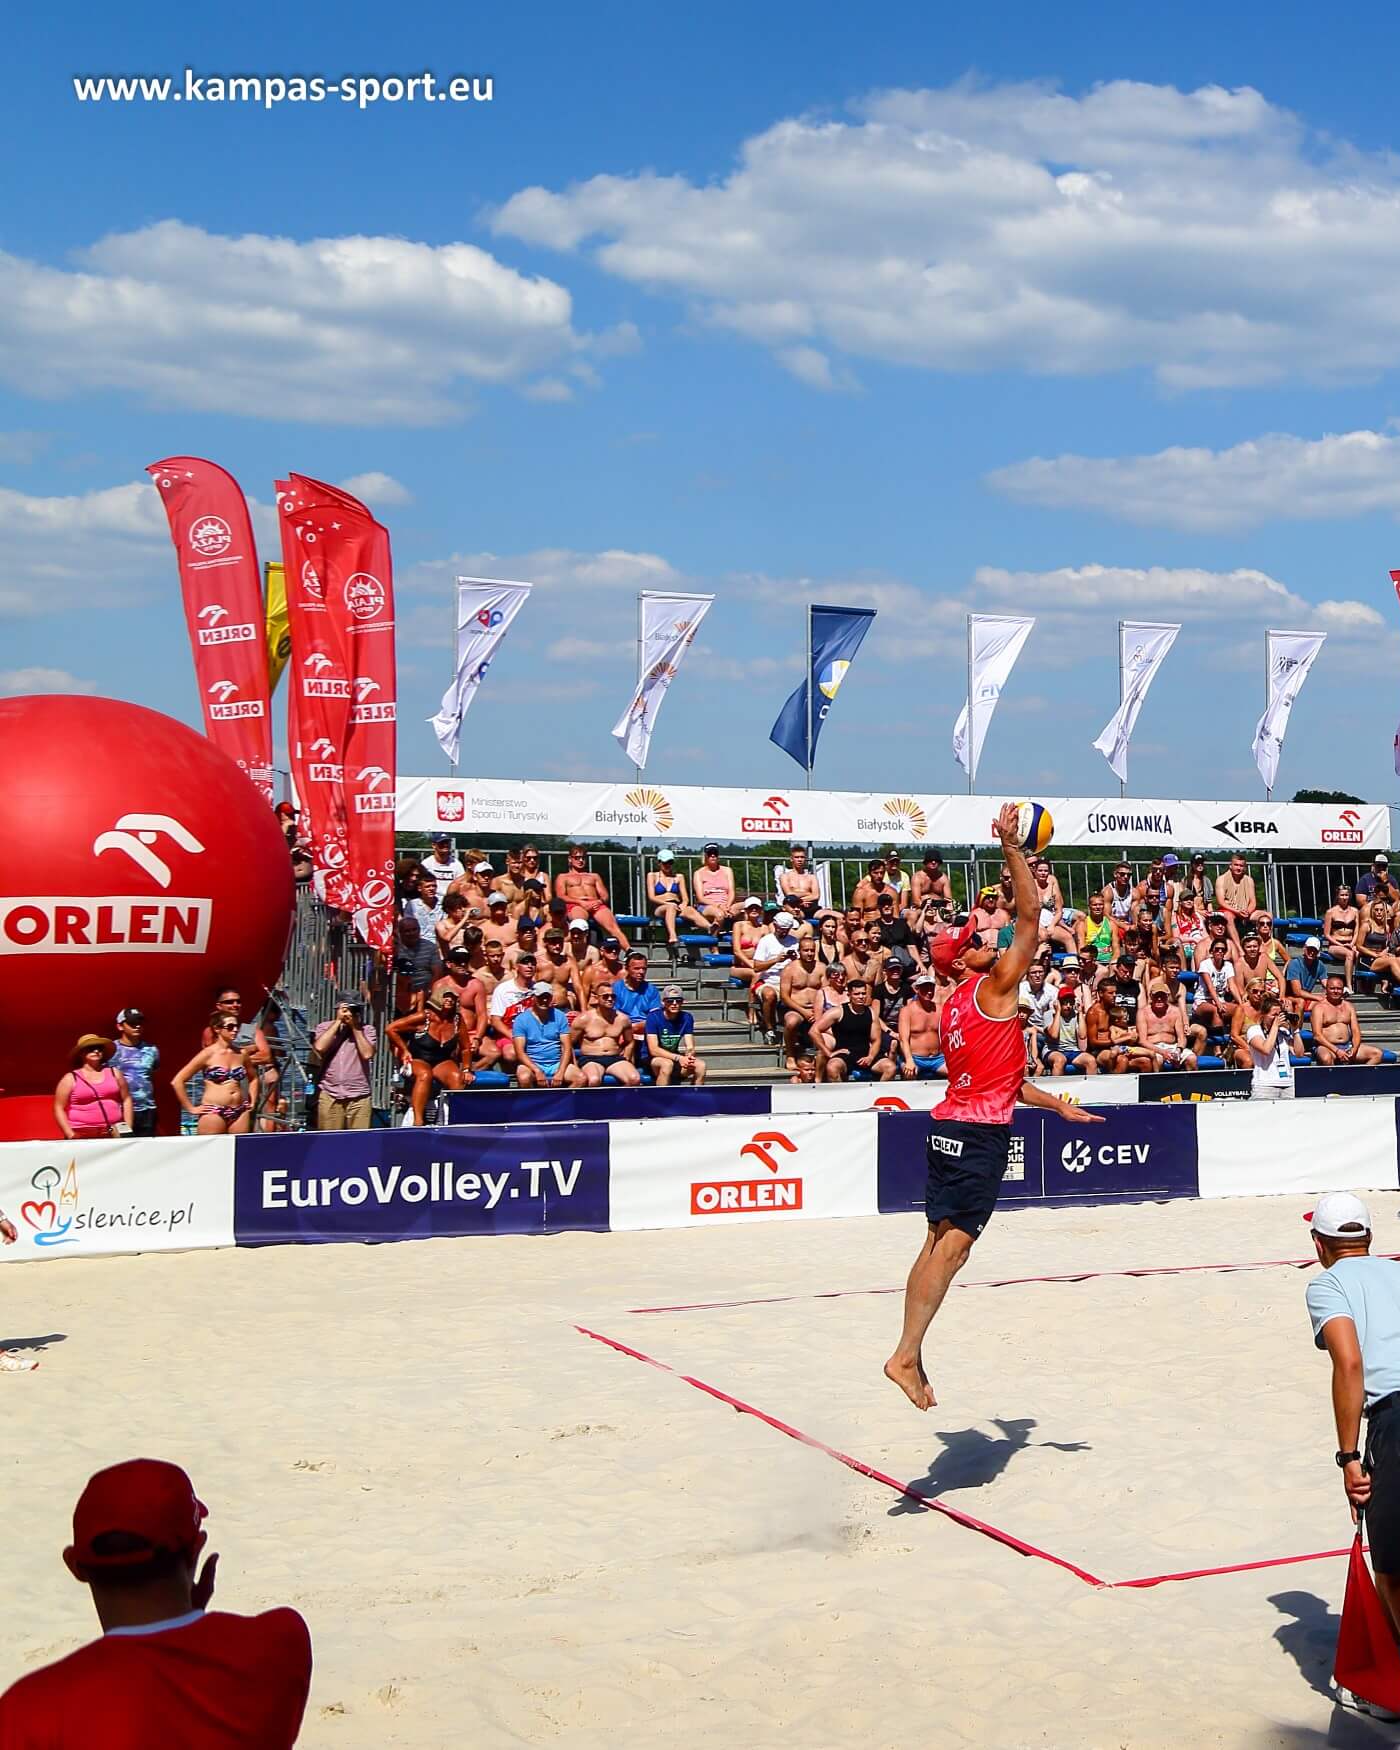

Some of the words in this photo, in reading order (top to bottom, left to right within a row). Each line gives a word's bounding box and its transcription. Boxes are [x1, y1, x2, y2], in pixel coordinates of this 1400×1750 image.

[471, 797, 528, 808] Ministerstwo
[471, 810, 501, 821] Sportu
[508, 811, 549, 822] Turystyki
[595, 810, 648, 825] Białystok
[743, 819, 791, 832] ORLEN
[857, 818, 905, 832] Białystok
[1087, 813, 1173, 836] CISOWIANKA
[1234, 820, 1279, 834] IBRA
[1323, 831, 1362, 842] ORLEN
[3, 904, 200, 946] ORLEN
[950, 1007, 959, 1026] 2
[948, 1028, 966, 1051] POL
[1213, 1090, 1251, 1098] VOLLEYBALL
[1097, 1143, 1150, 1166] CEV
[261, 1159, 582, 1209] EuroVolley.TV
[695, 1182, 797, 1210] ORLEN
